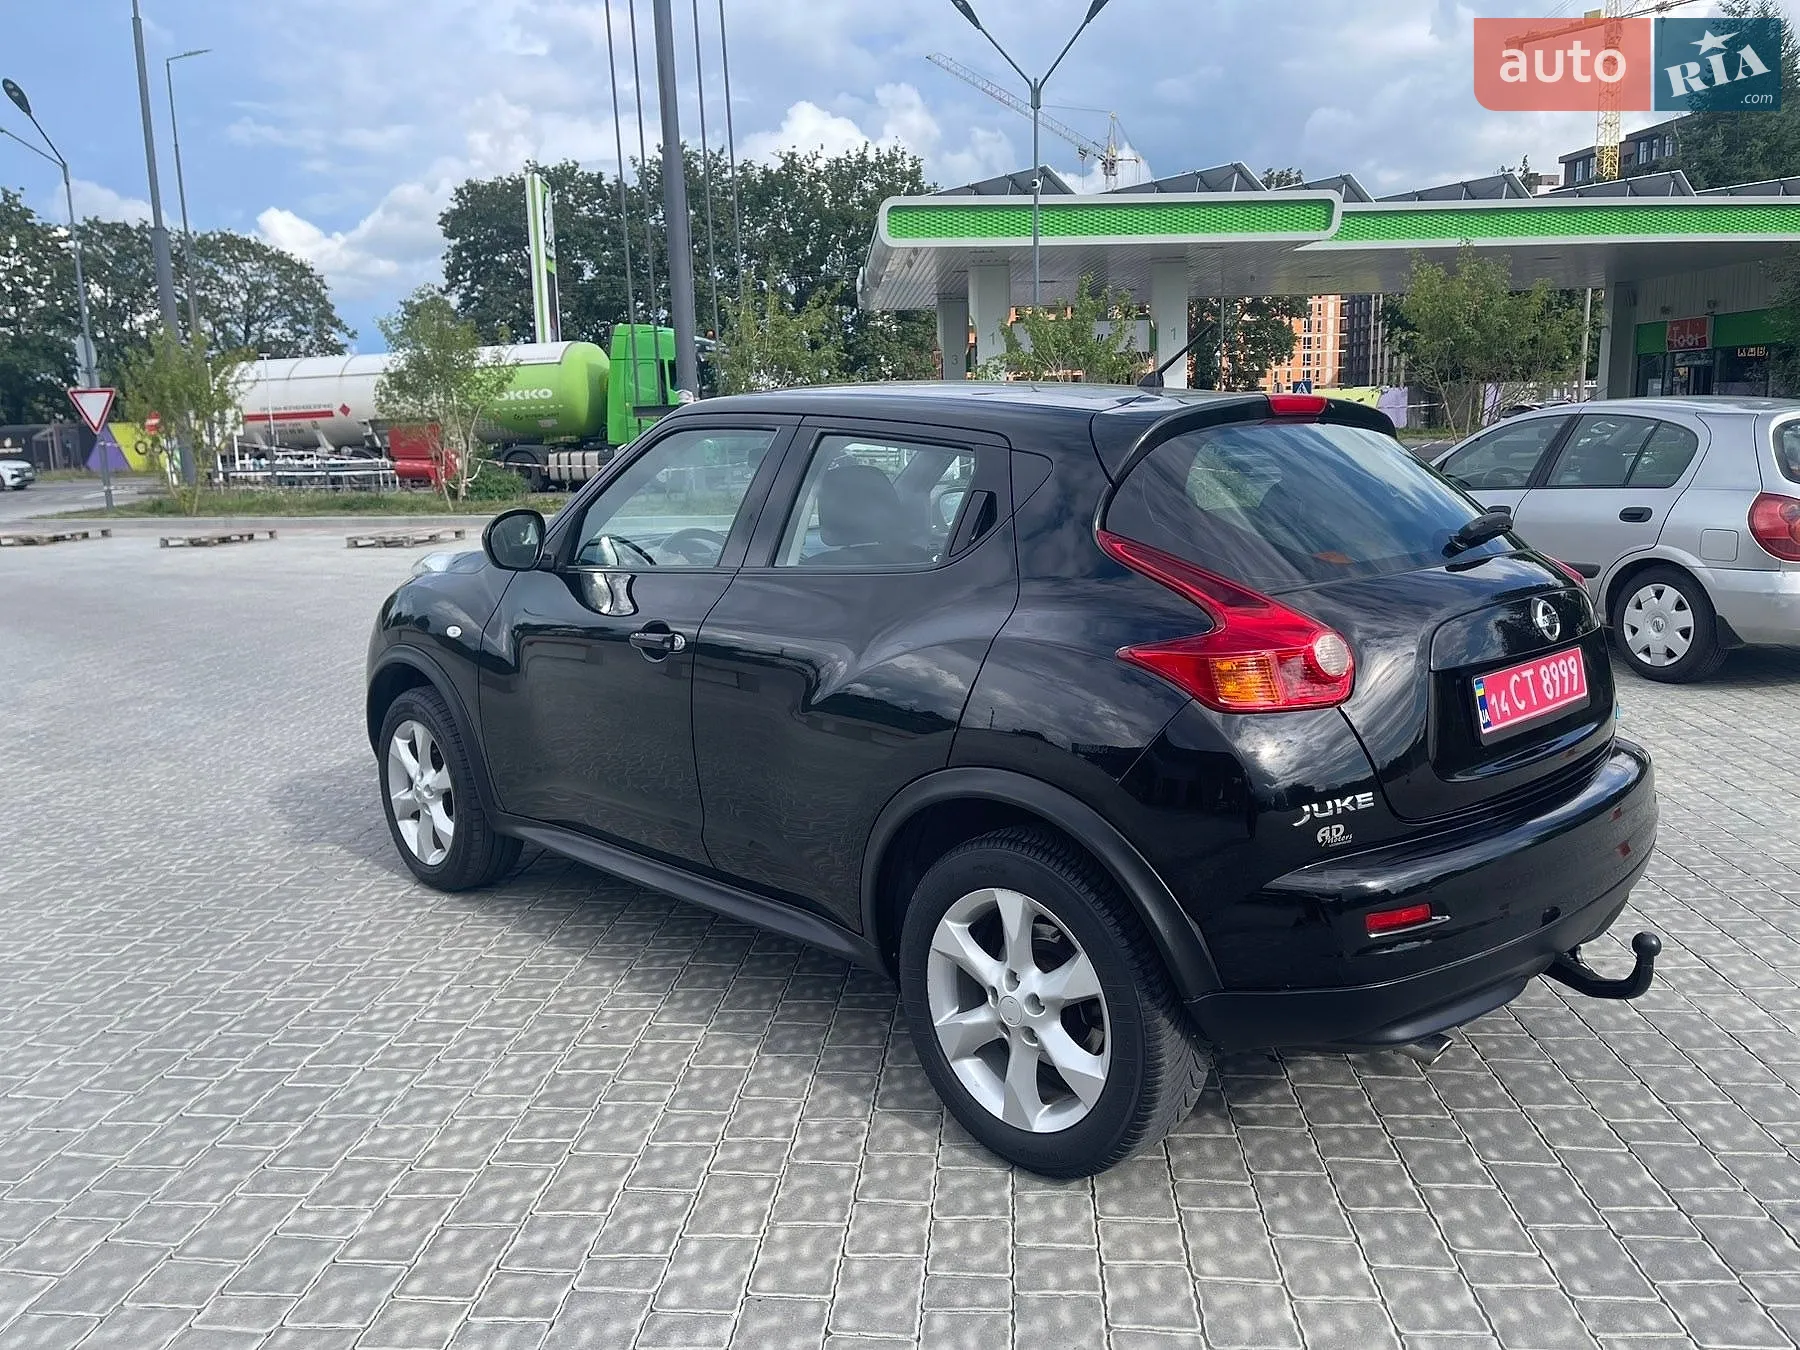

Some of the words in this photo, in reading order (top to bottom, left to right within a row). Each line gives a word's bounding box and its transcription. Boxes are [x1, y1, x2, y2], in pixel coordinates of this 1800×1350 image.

[1490, 690, 1511, 720] 14
[1539, 656, 1579, 700] 8999
[1480, 709, 1491, 723] UA
[1292, 792, 1375, 827] JUKE
